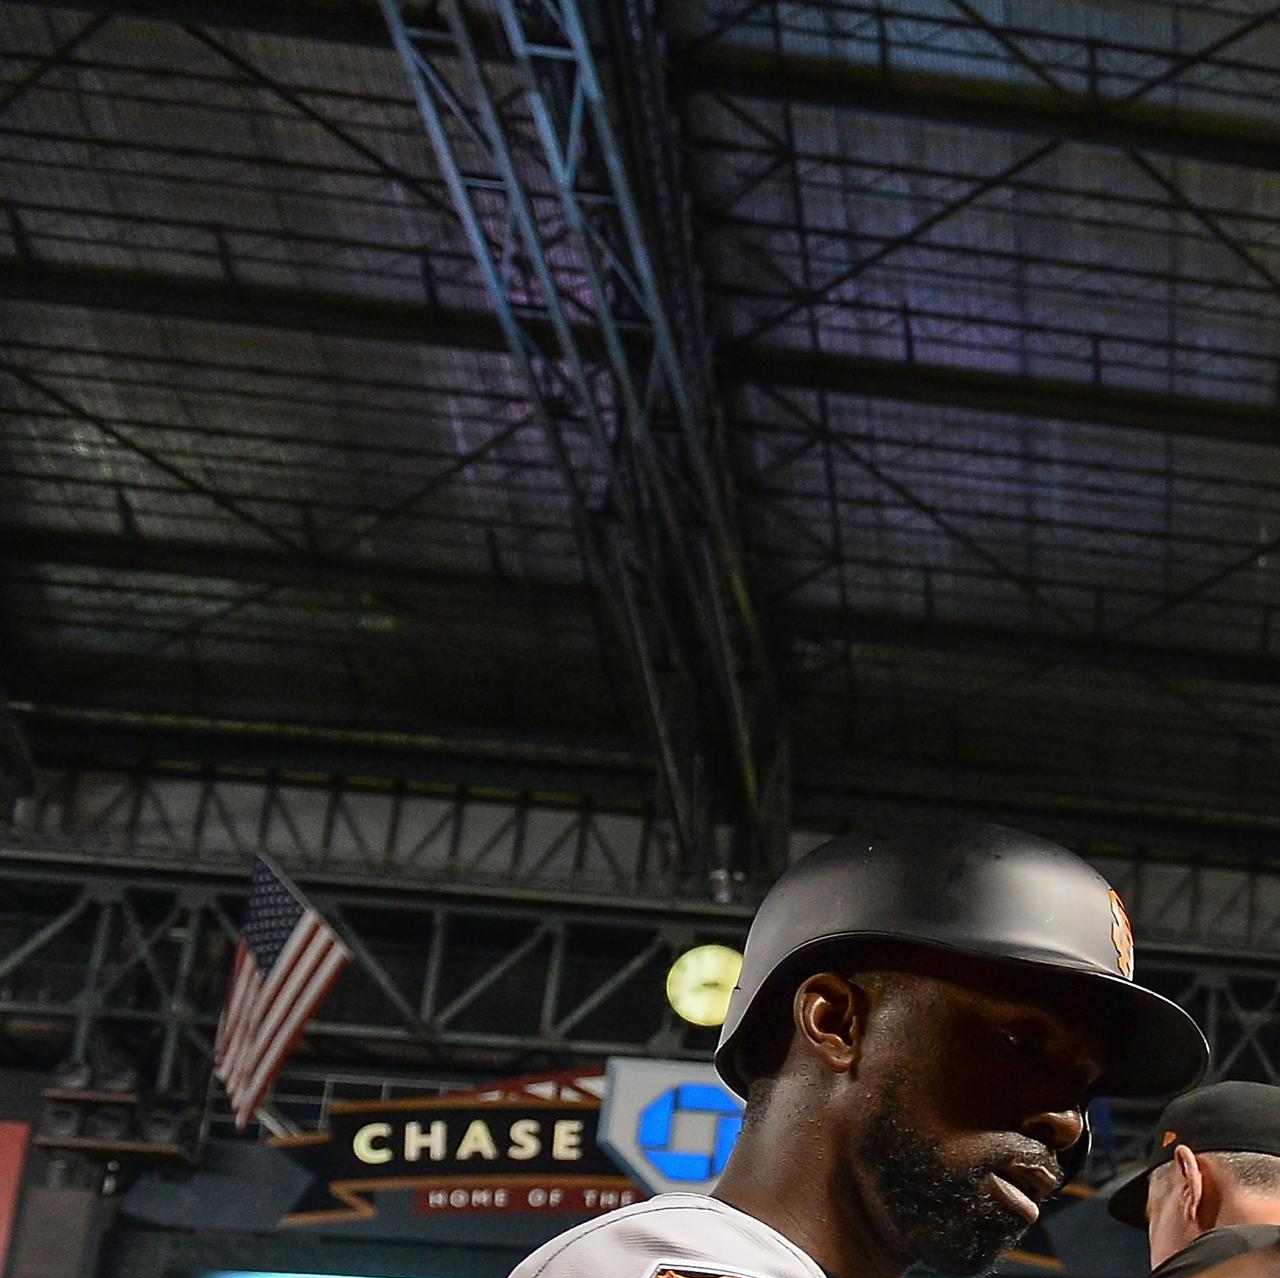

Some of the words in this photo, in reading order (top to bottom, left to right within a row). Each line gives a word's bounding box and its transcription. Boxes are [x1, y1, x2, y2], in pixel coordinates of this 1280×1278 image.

[353, 1119, 585, 1165] CHASE
[428, 1188, 510, 1208] HOME
[527, 1188, 564, 1208] OF
[583, 1189, 635, 1208] THE
